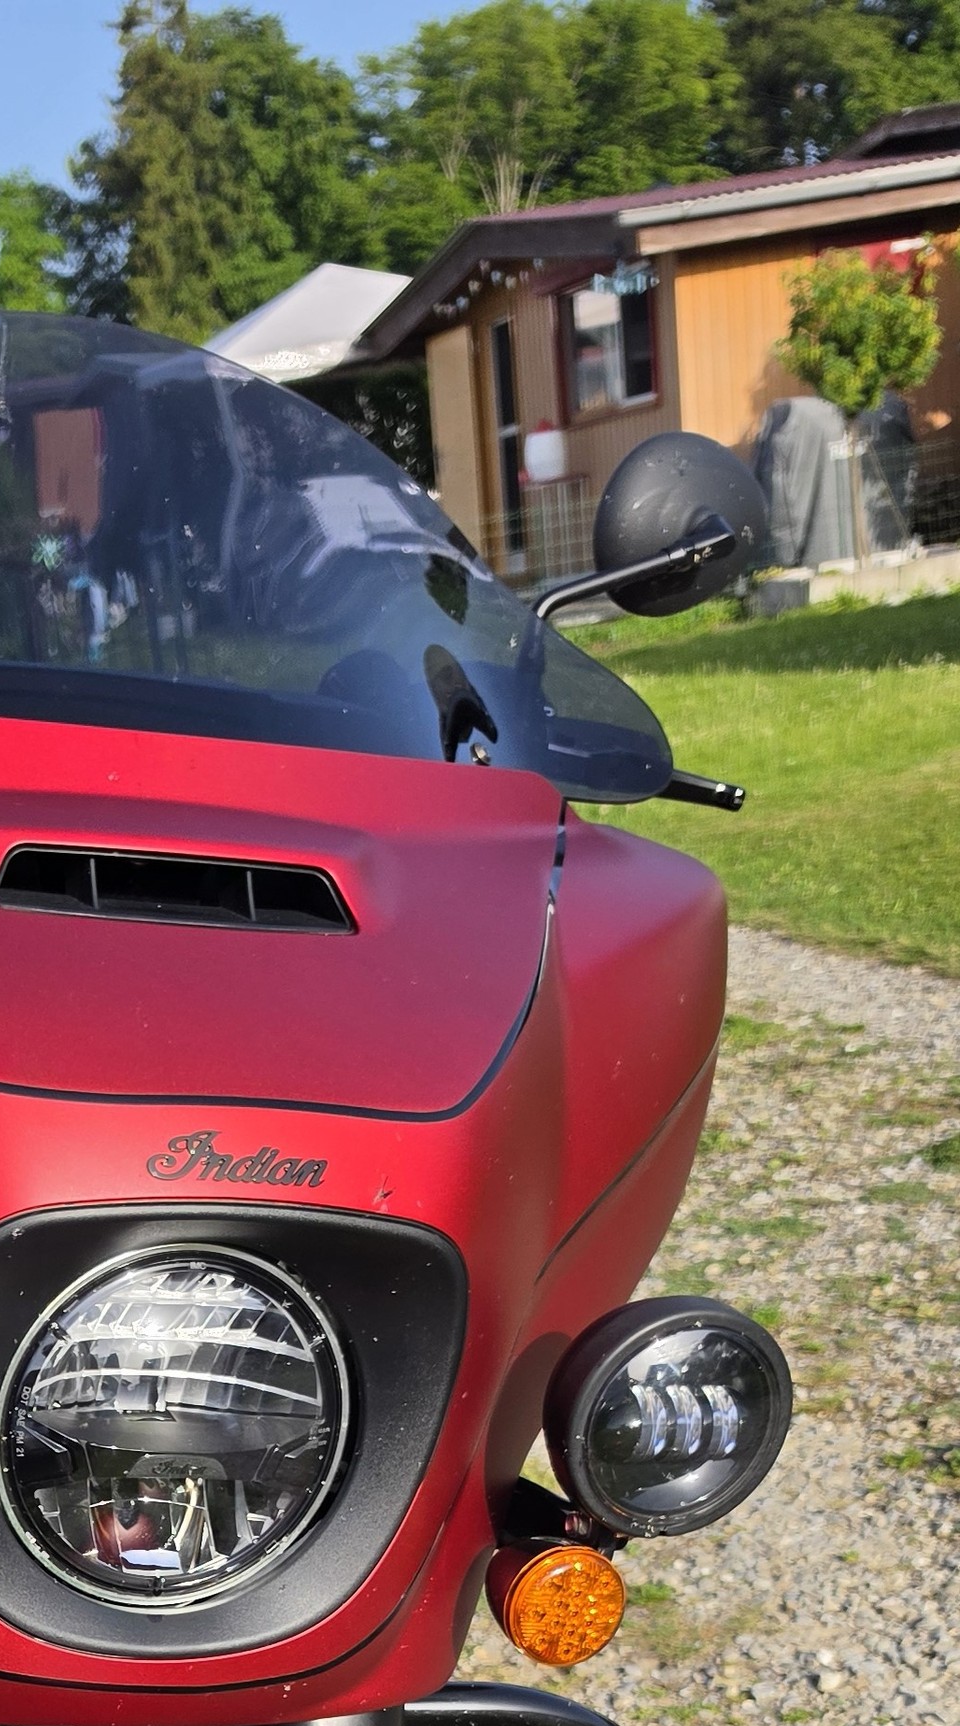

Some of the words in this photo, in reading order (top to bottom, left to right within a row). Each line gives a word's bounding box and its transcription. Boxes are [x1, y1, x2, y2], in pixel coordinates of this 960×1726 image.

[147, 1129, 328, 1187] Indian
[20, 1386, 32, 1406] DOT
[16, 1408, 27, 1427] SAE
[15, 1430, 25, 1444] PM
[16, 1447, 25, 1457] 21
